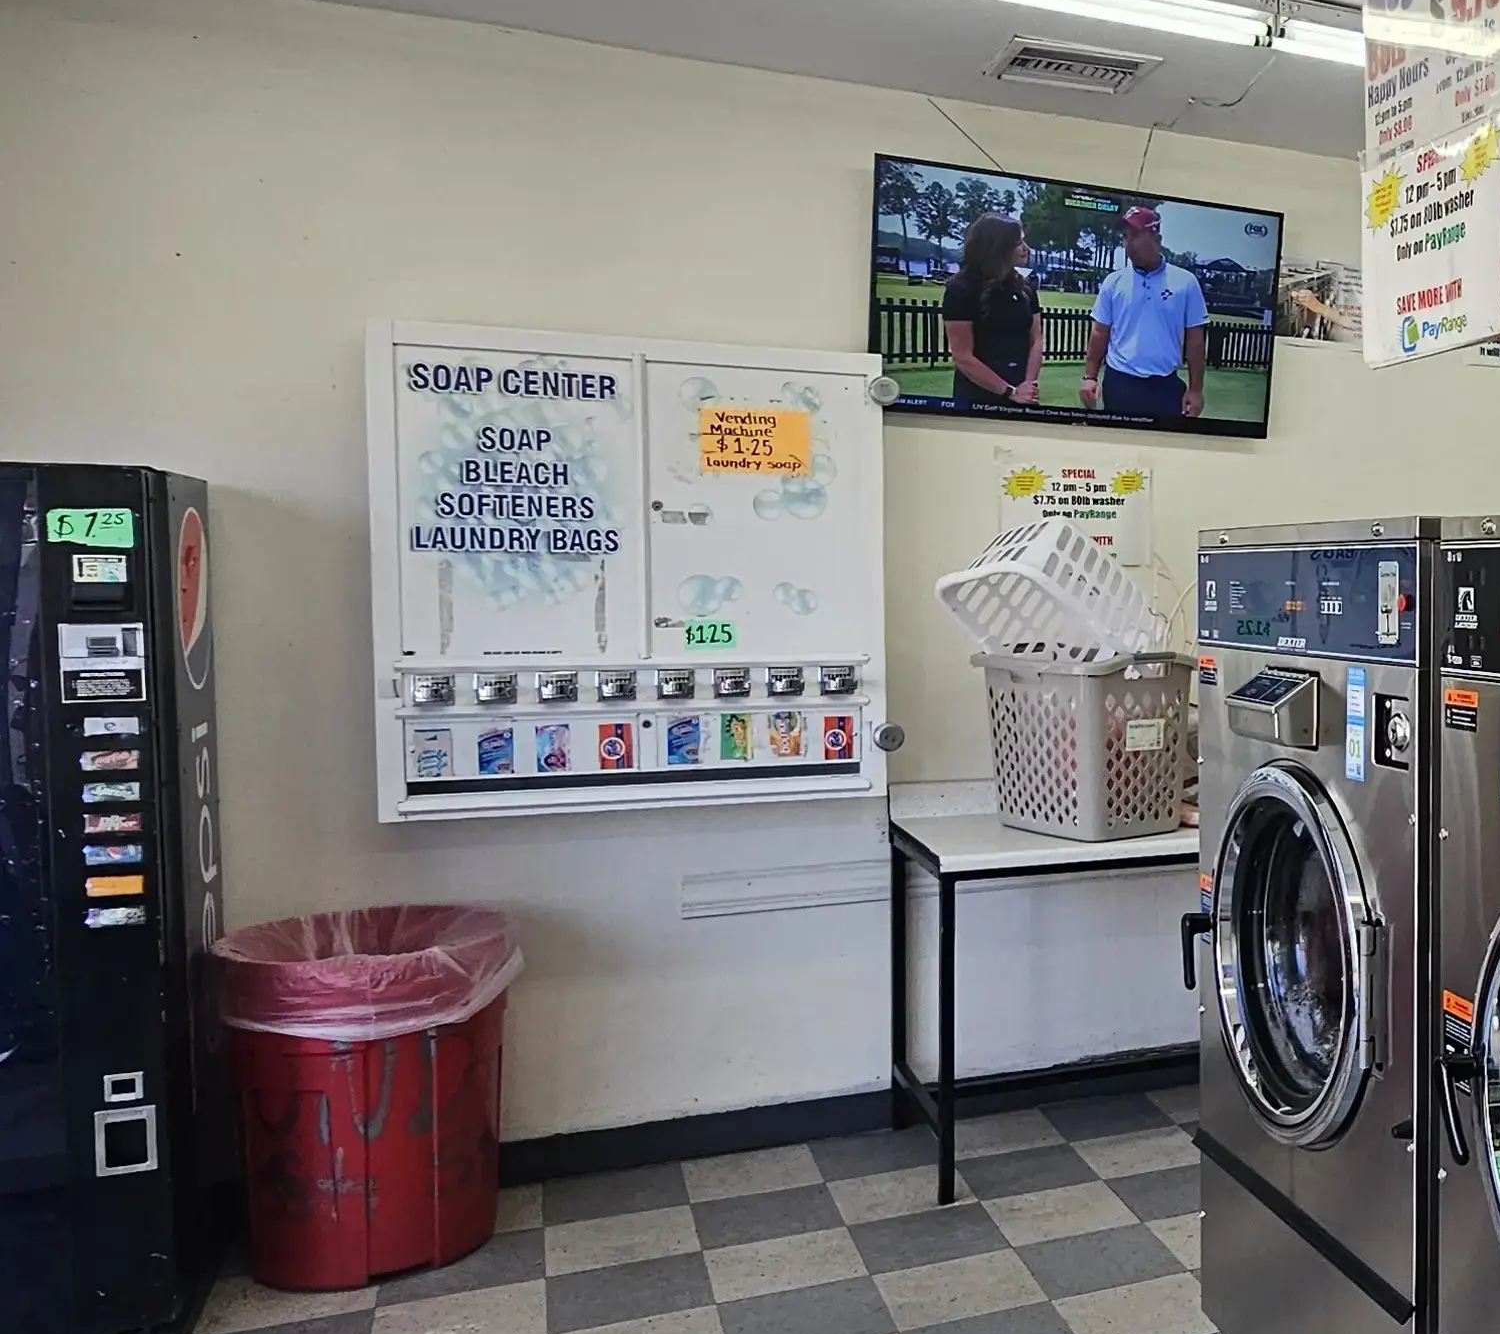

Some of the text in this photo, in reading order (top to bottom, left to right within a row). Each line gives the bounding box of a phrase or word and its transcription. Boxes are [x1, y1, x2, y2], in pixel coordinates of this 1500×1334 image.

[1399, 57, 1429, 90] Hours
[1437, 171, 1443, 192] 5
[1410, 211, 1422, 228] on
[1444, 189, 1475, 216] washer
[1414, 238, 1424, 254] on
[1424, 221, 1466, 253] PayRange
[1397, 278, 1463, 315] SAVE MORE WITH
[1422, 312, 1468, 340] PayRange
[410, 363, 616, 399] SOAP CENTER
[710, 424, 774, 437] Machine
[715, 412, 777, 428] Vending
[479, 426, 552, 452] SOAP
[463, 459, 569, 486] BLEACH
[767, 461, 801, 472] soap
[1061, 468, 1096, 479] SPECIAL
[1051, 482, 1107, 493] 12 pm 5 pm
[437, 492, 595, 519] SOFTENERS
[1033, 495, 1125, 506] $7.75 on 80lb washer
[1073, 509, 1117, 520] PayRange
[412, 525, 620, 552] LAUNDRY BAGS
[1277, 636, 1306, 648] DEXTER
[1349, 738, 1361, 759] 01
